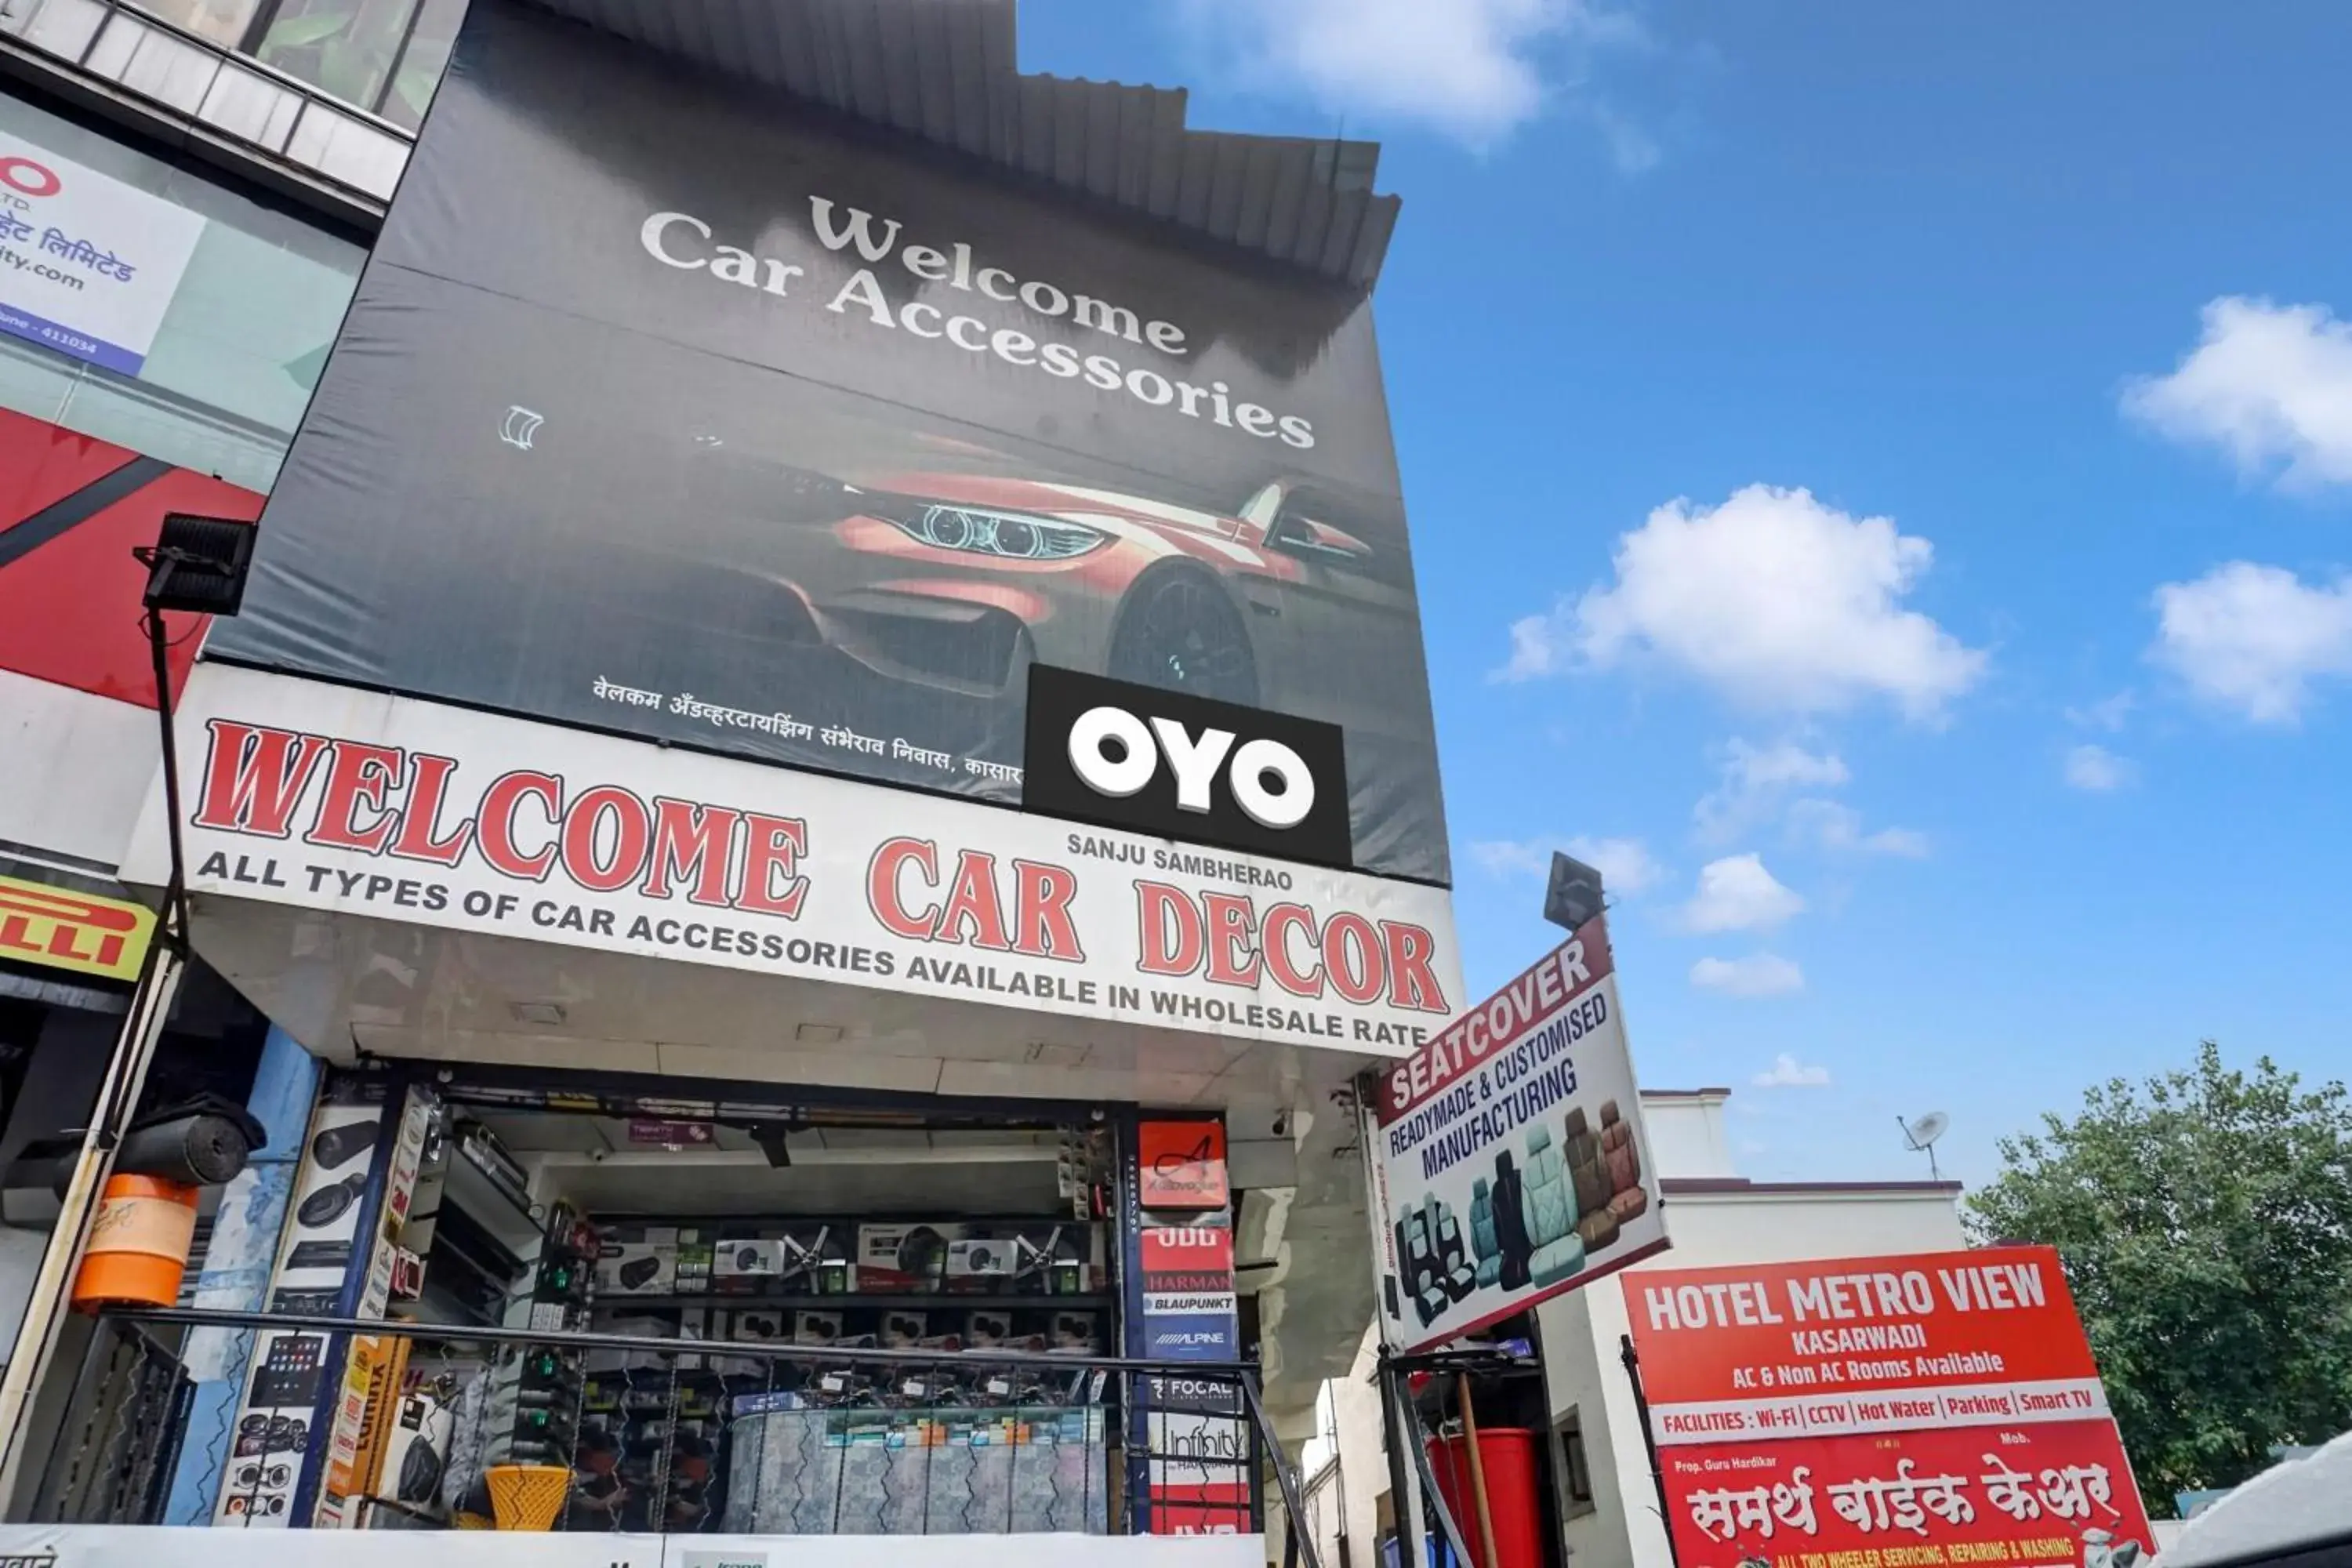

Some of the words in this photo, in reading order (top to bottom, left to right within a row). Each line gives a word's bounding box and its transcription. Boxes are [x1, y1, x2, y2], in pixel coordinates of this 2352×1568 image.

[38, 227, 137, 282] लिमिटेड
[809, 194, 1187, 354] Welcome
[41, 327, 97, 354] 411034
[640, 211, 804, 296] Car
[826, 269, 1316, 449] Accessories
[593, 674, 662, 709] वेलकम
[819, 724, 886, 756] संभेराव
[891, 738, 956, 772] निवास,
[1067, 705, 1316, 829] OYO
[191, 717, 811, 922] WELCOME
[1067, 833, 1145, 865] SANJU
[1153, 849, 1294, 891] SAMBHERAO
[197, 851, 287, 888] ALL
[305, 865, 449, 911] TYPES
[463, 890, 520, 920] OF
[532, 900, 616, 936] CAR
[626, 915, 895, 976] ACCESSORIES
[906, 956, 1097, 1004] AVAILABLE
[1109, 985, 1140, 1011] IN
[1150, 990, 1344, 1038] WHOLESALE
[1353, 1018, 1428, 1048] RATE
[866, 835, 1086, 967] CAR
[1133, 878, 1450, 1015] DECOR
[1392, 940, 1591, 1110] SEATCOVER
[1389, 1080, 1475, 1157] READYMADE
[1479, 1071, 1492, 1099] &
[1495, 993, 1607, 1091] CUSTOMISED
[1421, 1058, 1577, 1180] MANUFACTURING
[1155, 1298, 1233, 1309] BLAUPUNKT
[1644, 1283, 1784, 1330] HOTEL
[1786, 1270, 1935, 1322] METRO
[1937, 1263, 2045, 1312] VIEW
[1733, 1367, 1757, 1388] AC
[1761, 1367, 1773, 1387] &
[1777, 1364, 1817, 1385] Non
[1821, 1362, 1845, 1383] AC
[1847, 1358, 1911, 1381] Rooms
[1915, 1352, 2004, 1376] Available
[1791, 1323, 1927, 1356] KASARWADI
[1171, 1381, 1232, 1395] FOCAL
[1663, 1412, 1745, 1433] FACILITIES
[1756, 1407, 1798, 1428] Wi-Fi
[1809, 1405, 1847, 1424] CCTV
[1858, 1402, 1887, 1420] Hot
[1889, 1401, 1936, 1419] Water
[1947, 1395, 2011, 1414] Parking
[2020, 1392, 2068, 1410] Smart
[2070, 1390, 2092, 1407] TV
[1171, 1425, 1243, 1457] Infinity
[1675, 1461, 1702, 1474] Prop.
[1705, 1458, 1730, 1471] Guru
[1733, 1457, 1777, 1469] Hardikar
[2000, 1432, 2031, 1444] Mob.
[1686, 1466, 1819, 1543] समर्थ
[1826, 1458, 1976, 1537] बाईक
[1980, 1453, 2122, 1522] केअर
[1778, 1554, 1798, 1568] ALL
[1800, 1552, 1826, 1568] TWO
[1827, 1549, 1880, 1568] WHEELER
[1882, 1544, 1948, 1566] SERVICING,
[1949, 1541, 2009, 1563] REPAIRING
[2010, 1542, 2020, 1559] &
[2021, 1537, 2075, 1558] WASHING
